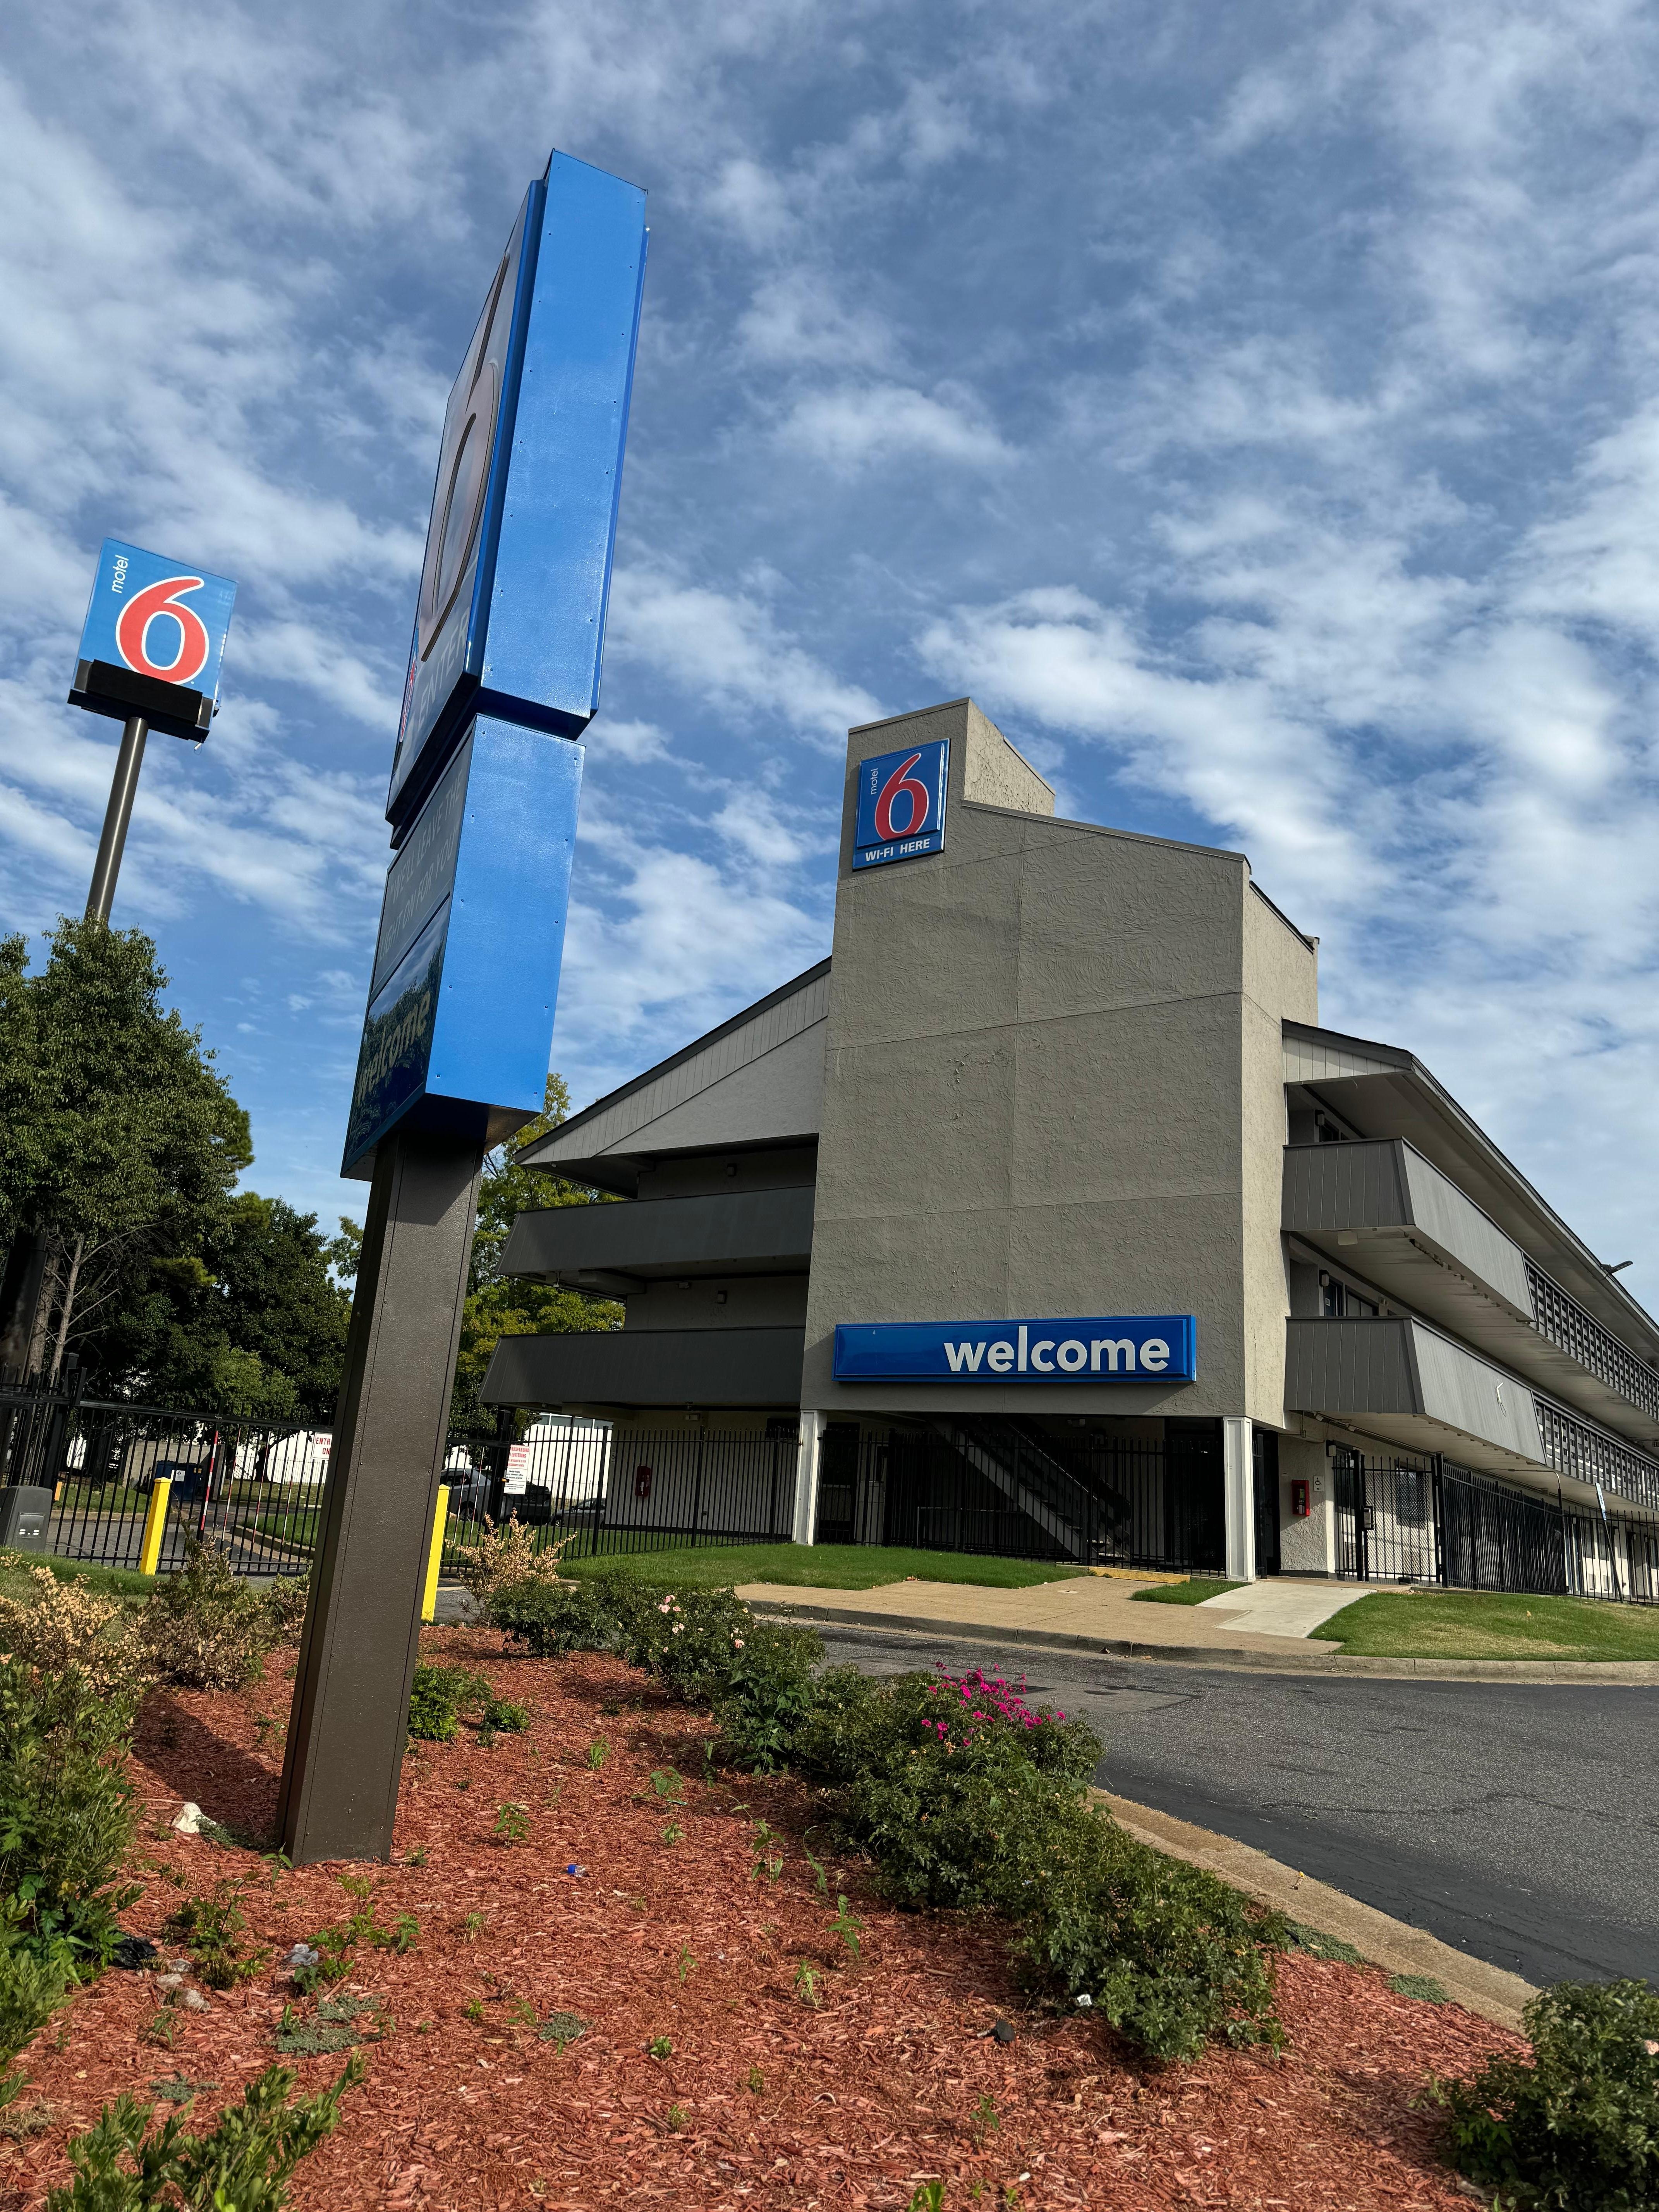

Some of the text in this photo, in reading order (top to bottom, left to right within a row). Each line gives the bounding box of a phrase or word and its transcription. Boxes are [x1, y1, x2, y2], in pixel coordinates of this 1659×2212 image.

[112, 555, 129, 593] motel
[116, 576, 210, 685] 6
[418, 606, 470, 732] ENTER
[416, 802, 443, 867] LEAVE
[445, 768, 462, 821] THE
[870, 768, 879, 795] motel
[875, 753, 929, 841] 6
[866, 838, 930, 862] WI-FI HERE
[379, 910, 403, 963] LIGHT
[402, 888, 418, 930] ON
[417, 862, 434, 904] FOR
[944, 1325, 1170, 1372] welcome
